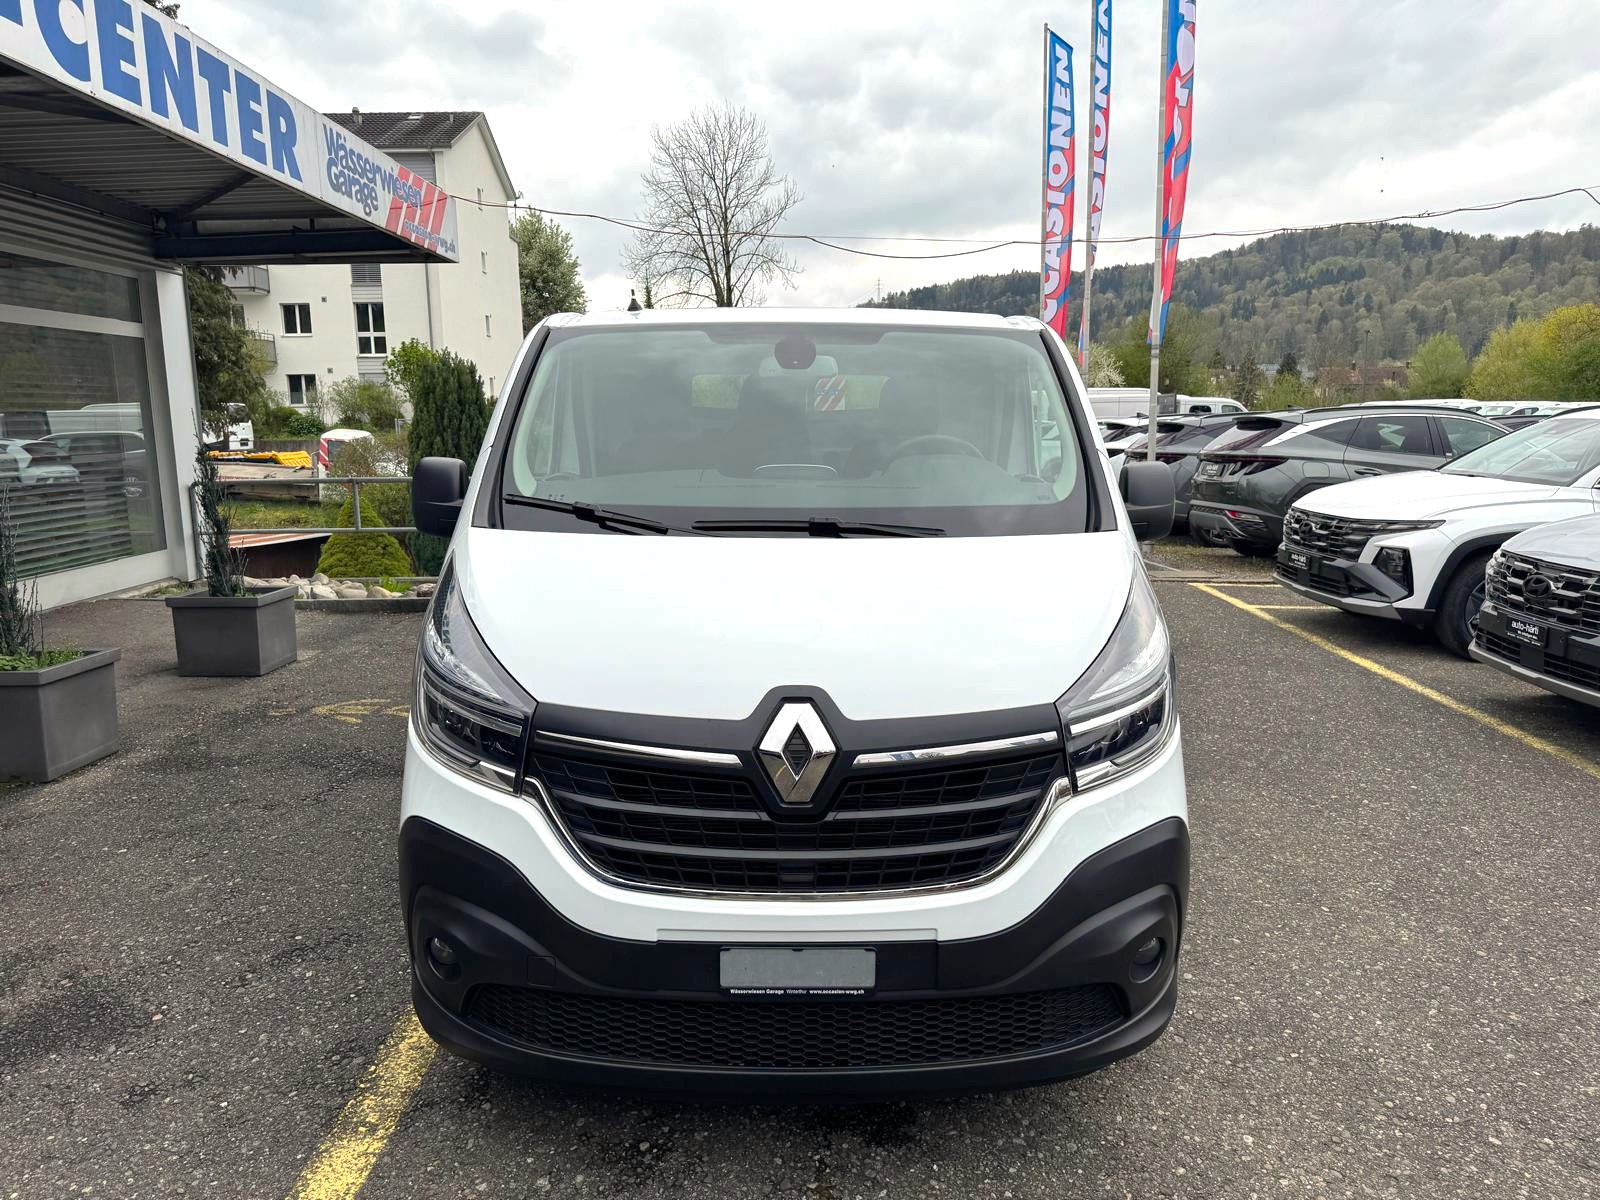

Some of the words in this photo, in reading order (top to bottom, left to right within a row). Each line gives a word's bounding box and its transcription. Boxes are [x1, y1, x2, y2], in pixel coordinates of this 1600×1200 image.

[33, 0, 303, 183] CENTER
[1043, 42, 1072, 324] CCASIONEN
[326, 156, 379, 217] Garage
